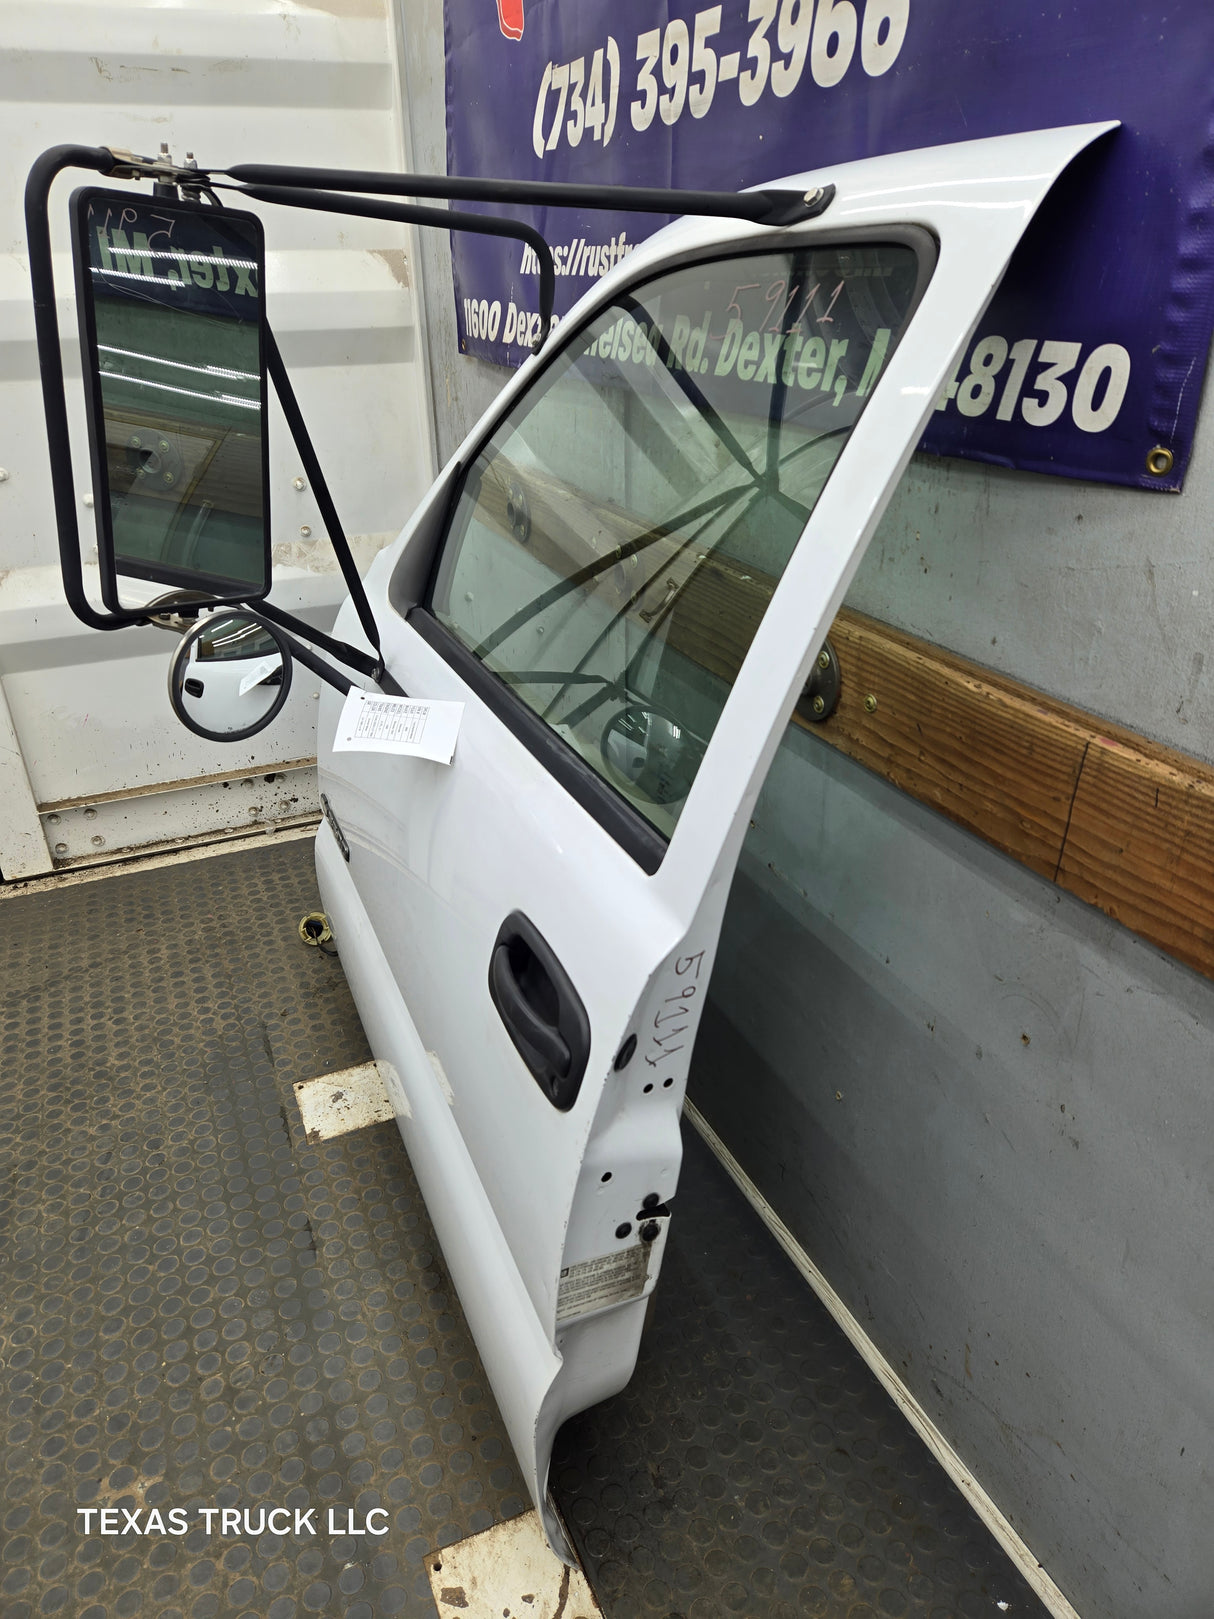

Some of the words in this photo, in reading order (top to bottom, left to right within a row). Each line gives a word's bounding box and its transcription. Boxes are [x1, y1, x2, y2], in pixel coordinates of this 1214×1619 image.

[532, 35, 620, 159] (734)
[630, 0, 910, 131] 395-3966
[464, 298, 501, 342] 11600
[666, 311, 709, 374] Rd.
[715, 318, 848, 406] Dexter,
[710, 280, 845, 341] 59111
[644, 950, 705, 1068] 59111
